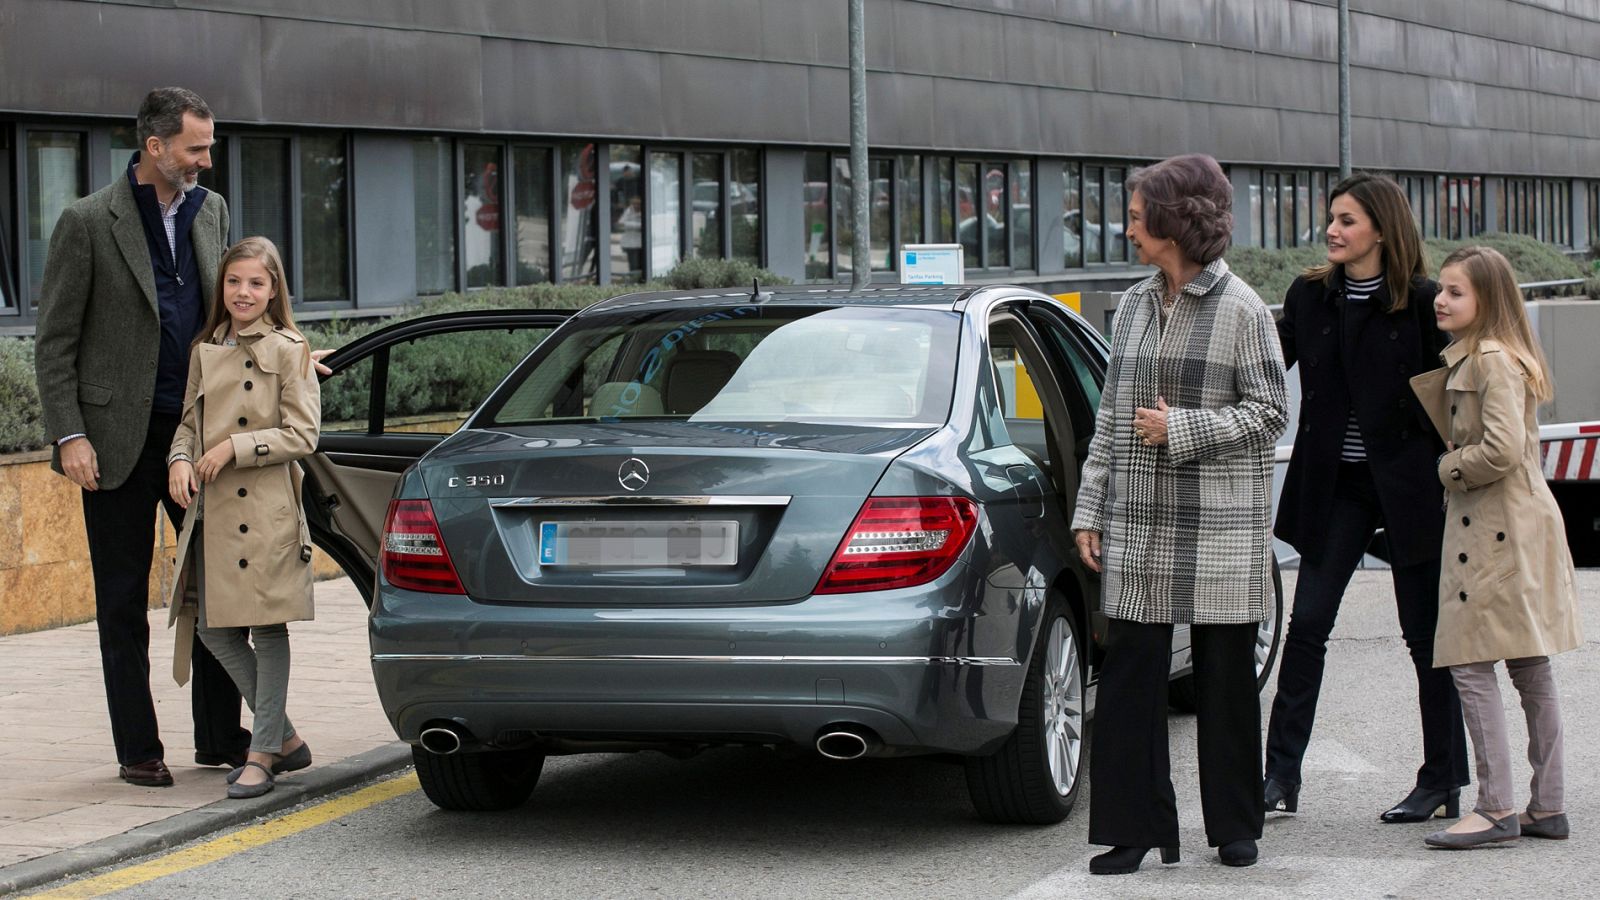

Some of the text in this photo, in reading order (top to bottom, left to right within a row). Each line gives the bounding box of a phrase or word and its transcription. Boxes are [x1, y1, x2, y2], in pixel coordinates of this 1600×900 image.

[448, 474, 505, 488] C 350
[544, 547, 552, 557] E
